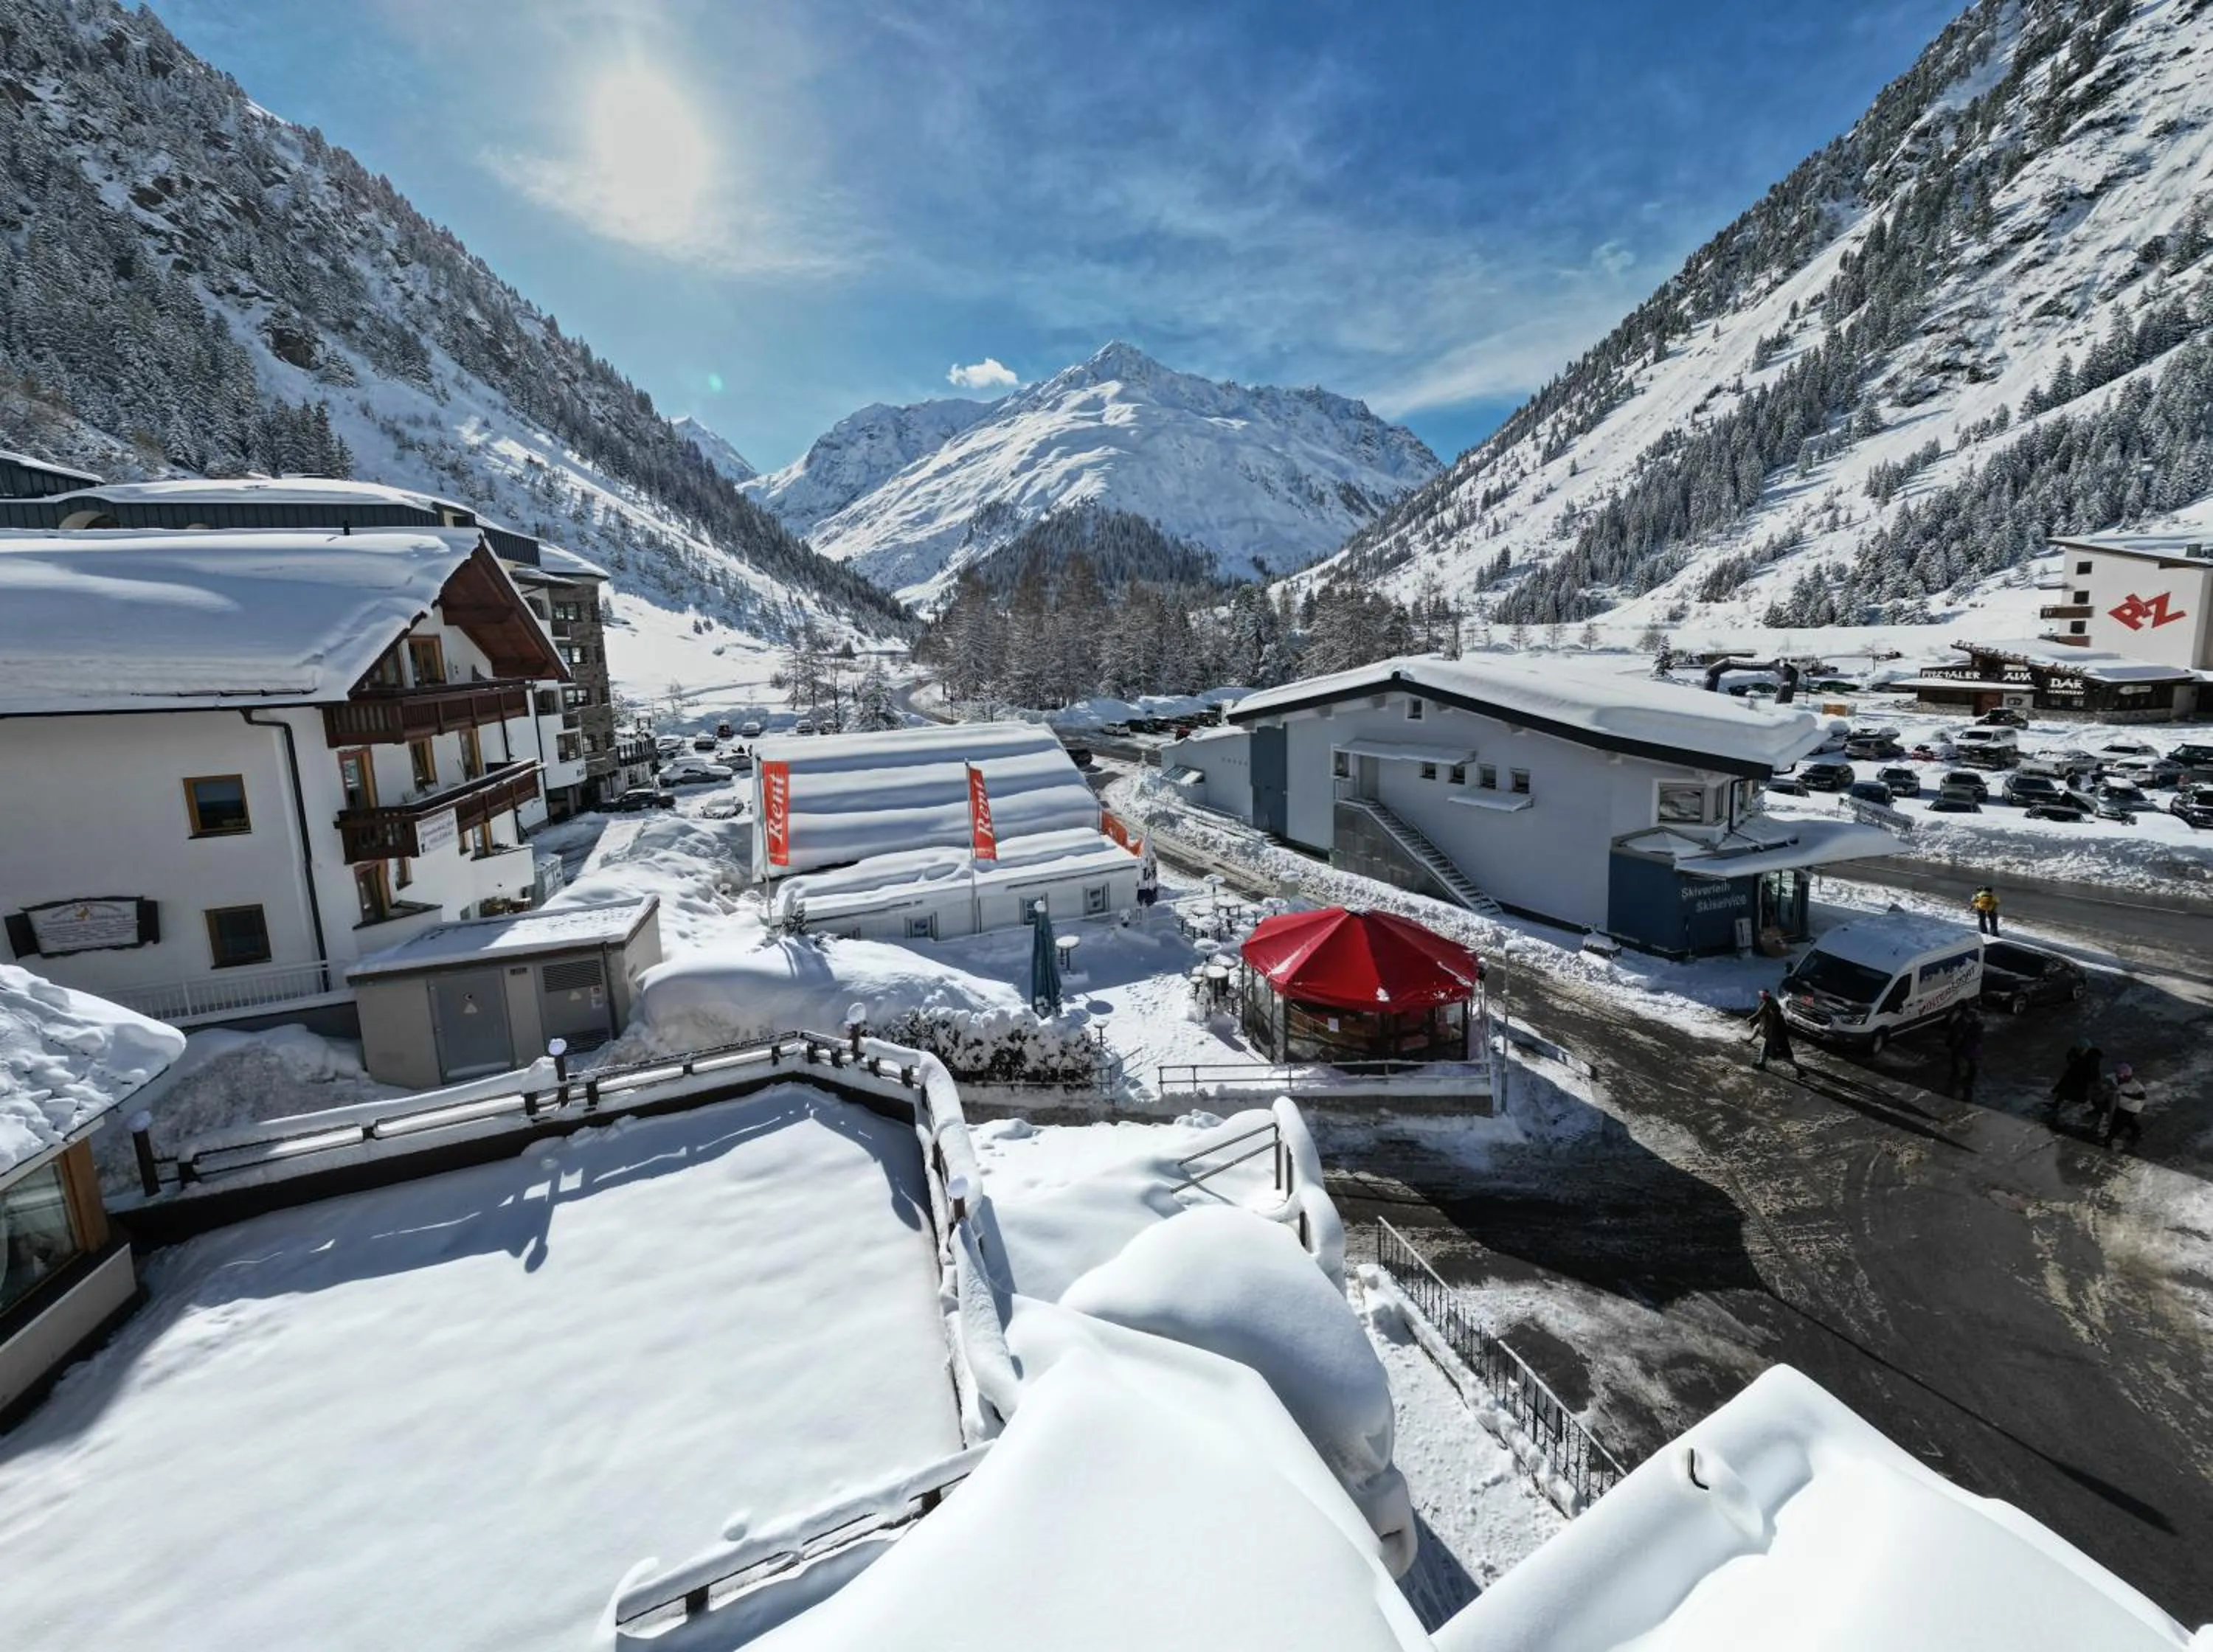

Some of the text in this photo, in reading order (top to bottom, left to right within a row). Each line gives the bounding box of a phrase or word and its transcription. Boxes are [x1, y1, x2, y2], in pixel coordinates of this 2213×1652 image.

[769, 773, 785, 844] Rent
[974, 779, 994, 839] Rent
[1696, 894, 1747, 914] Skiservice
